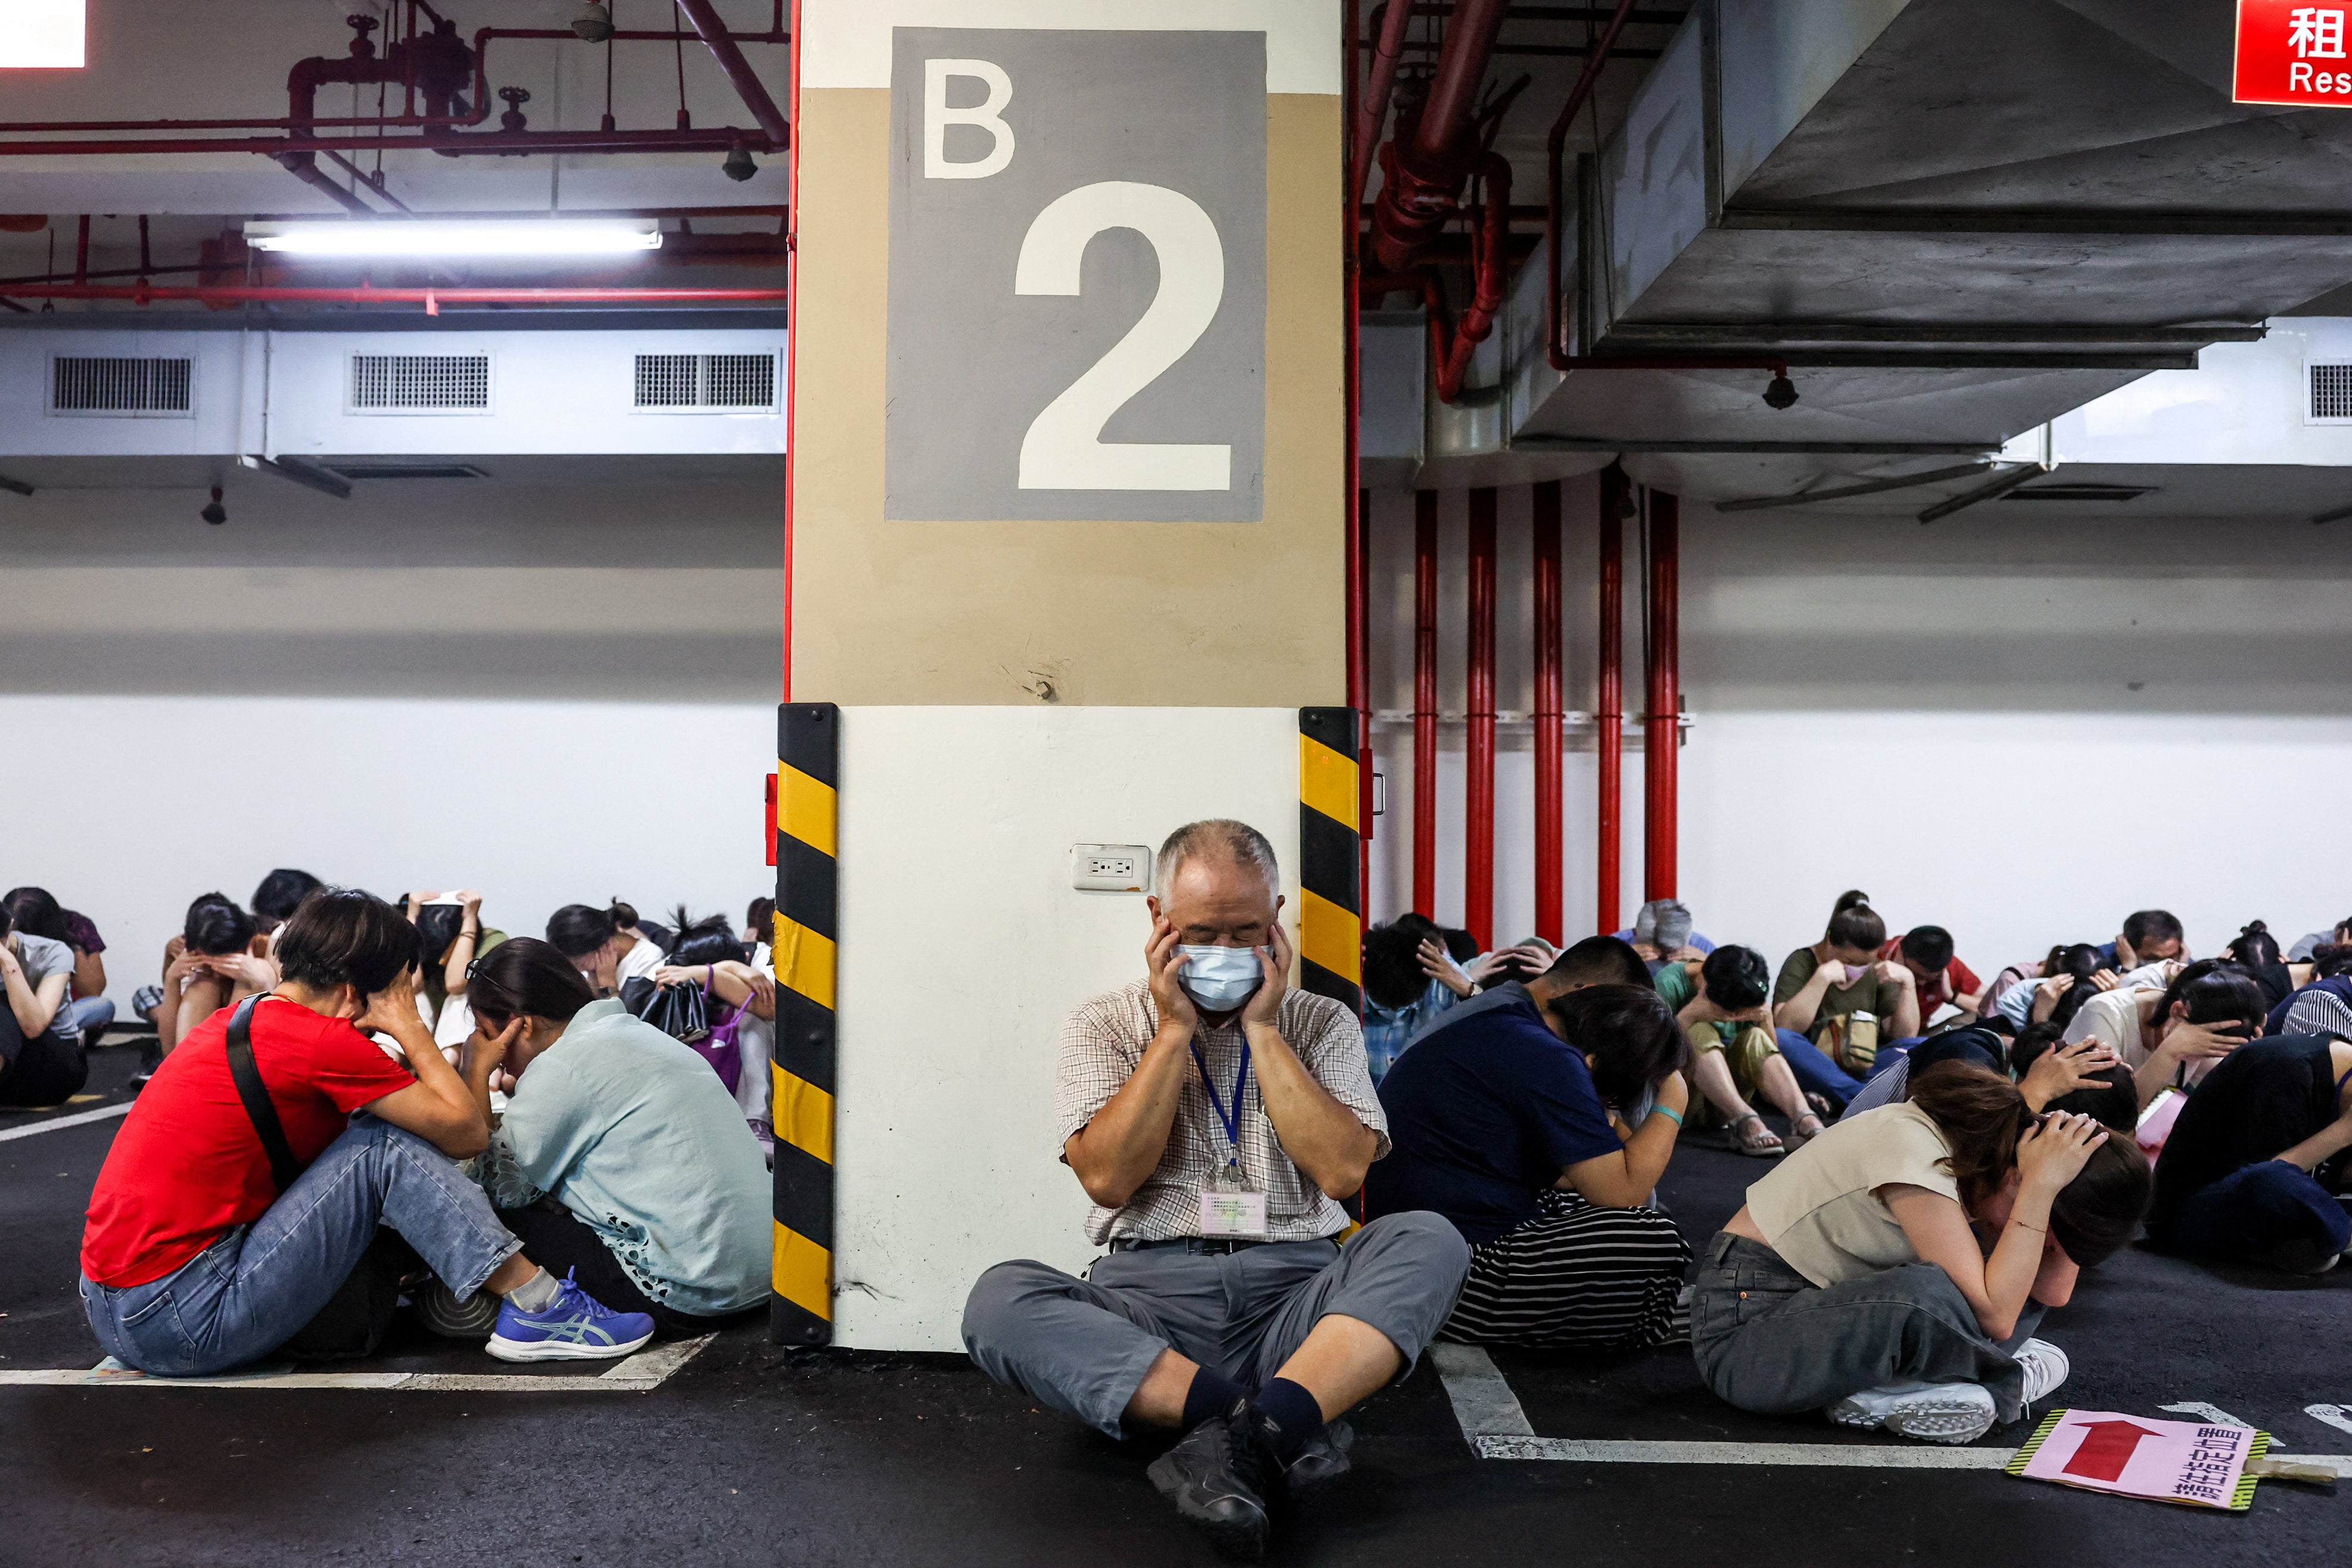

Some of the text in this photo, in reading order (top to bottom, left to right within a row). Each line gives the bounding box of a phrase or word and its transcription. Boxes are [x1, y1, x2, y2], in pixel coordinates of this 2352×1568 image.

[2287, 7, 2347, 58] 租
[2289, 62, 2352, 94] Res
[924, 58, 1016, 179] B
[1015, 181, 1231, 491] 2
[2171, 1427, 2242, 1501] 請往指定位置
